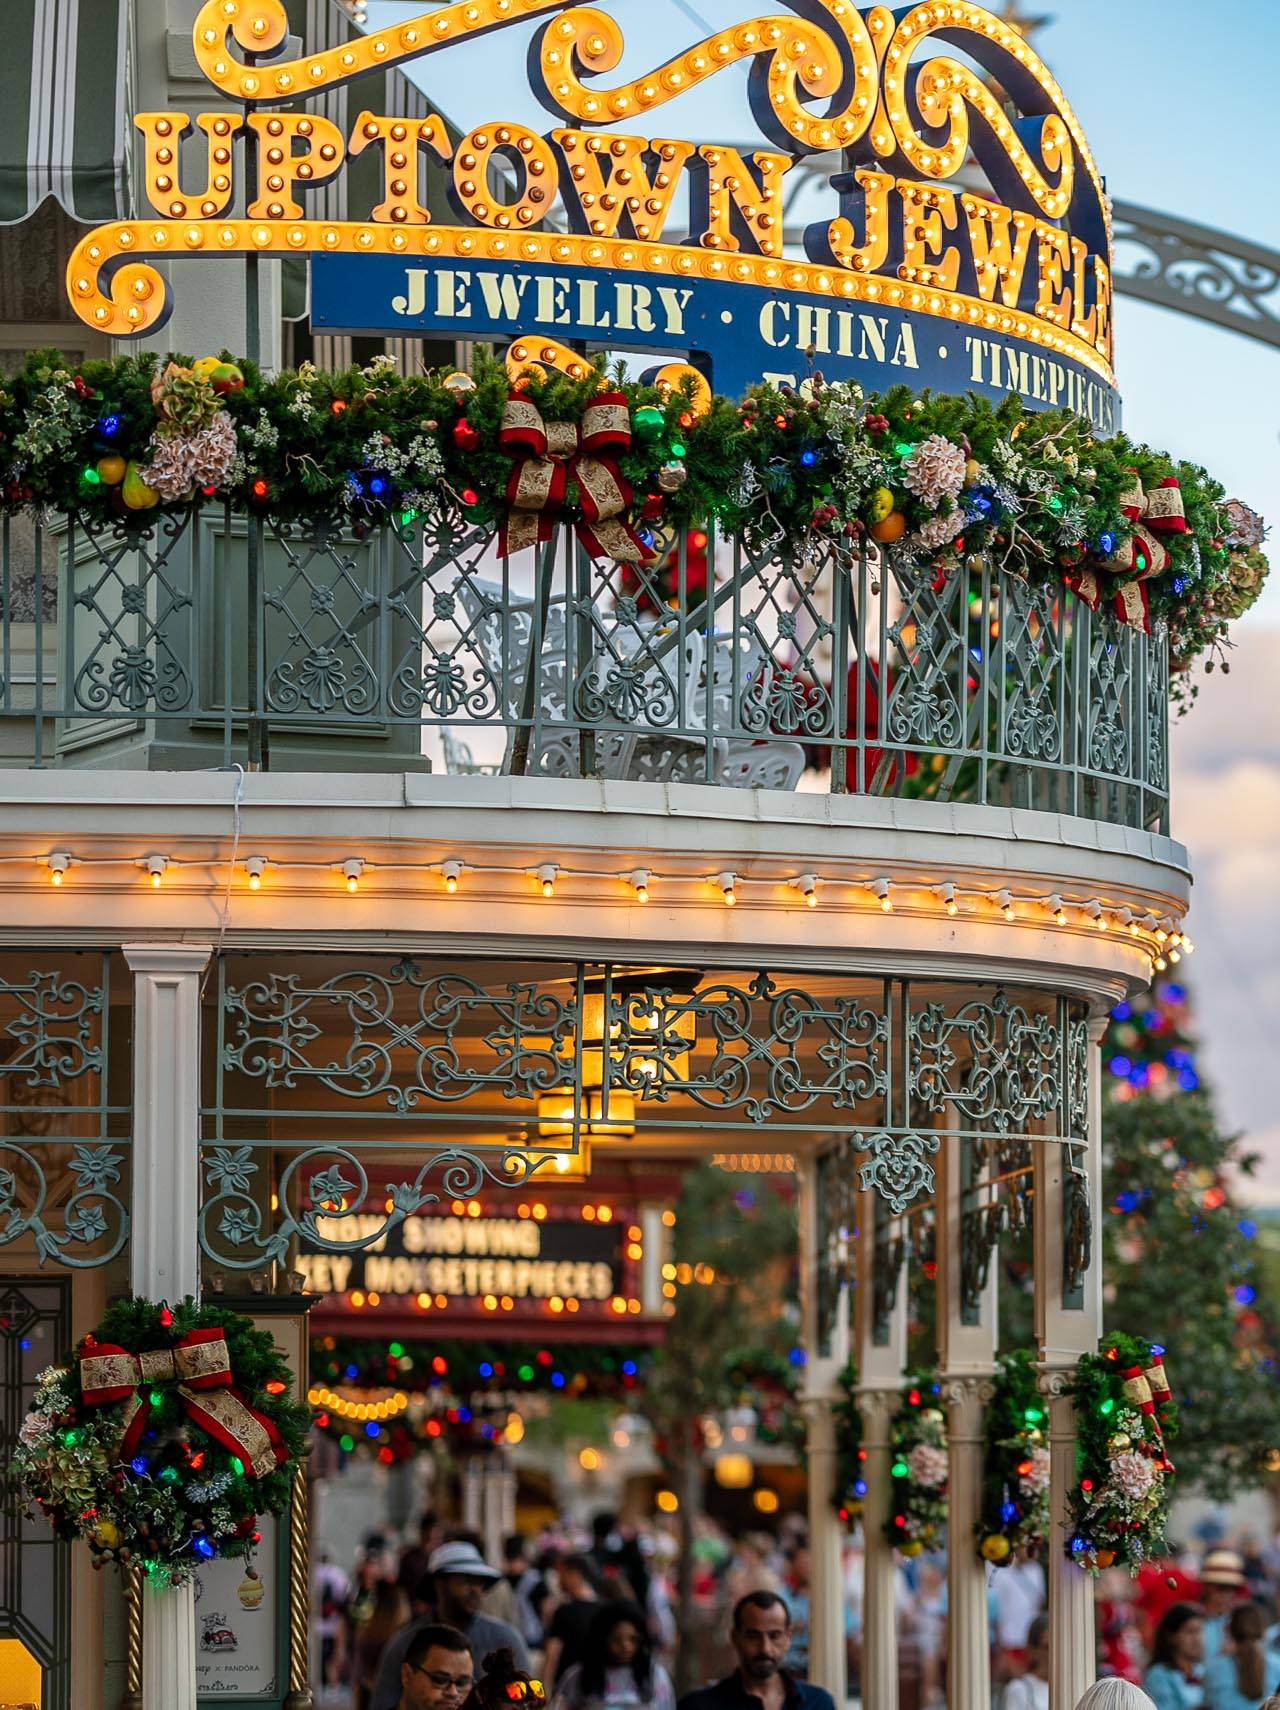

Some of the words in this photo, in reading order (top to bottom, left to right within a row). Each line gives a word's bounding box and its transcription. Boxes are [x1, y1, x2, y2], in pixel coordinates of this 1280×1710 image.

[134, 112, 793, 259] UPTOWN
[391, 267, 694, 336] JEWELRY
[758, 299, 920, 369] CHINA
[315, 1213, 388, 1253] NOW
[402, 1214, 541, 1258] SHOWING
[364, 1255, 614, 1301] MOUSETERPIECES
[224, 1664, 260, 1672] PANDORA
